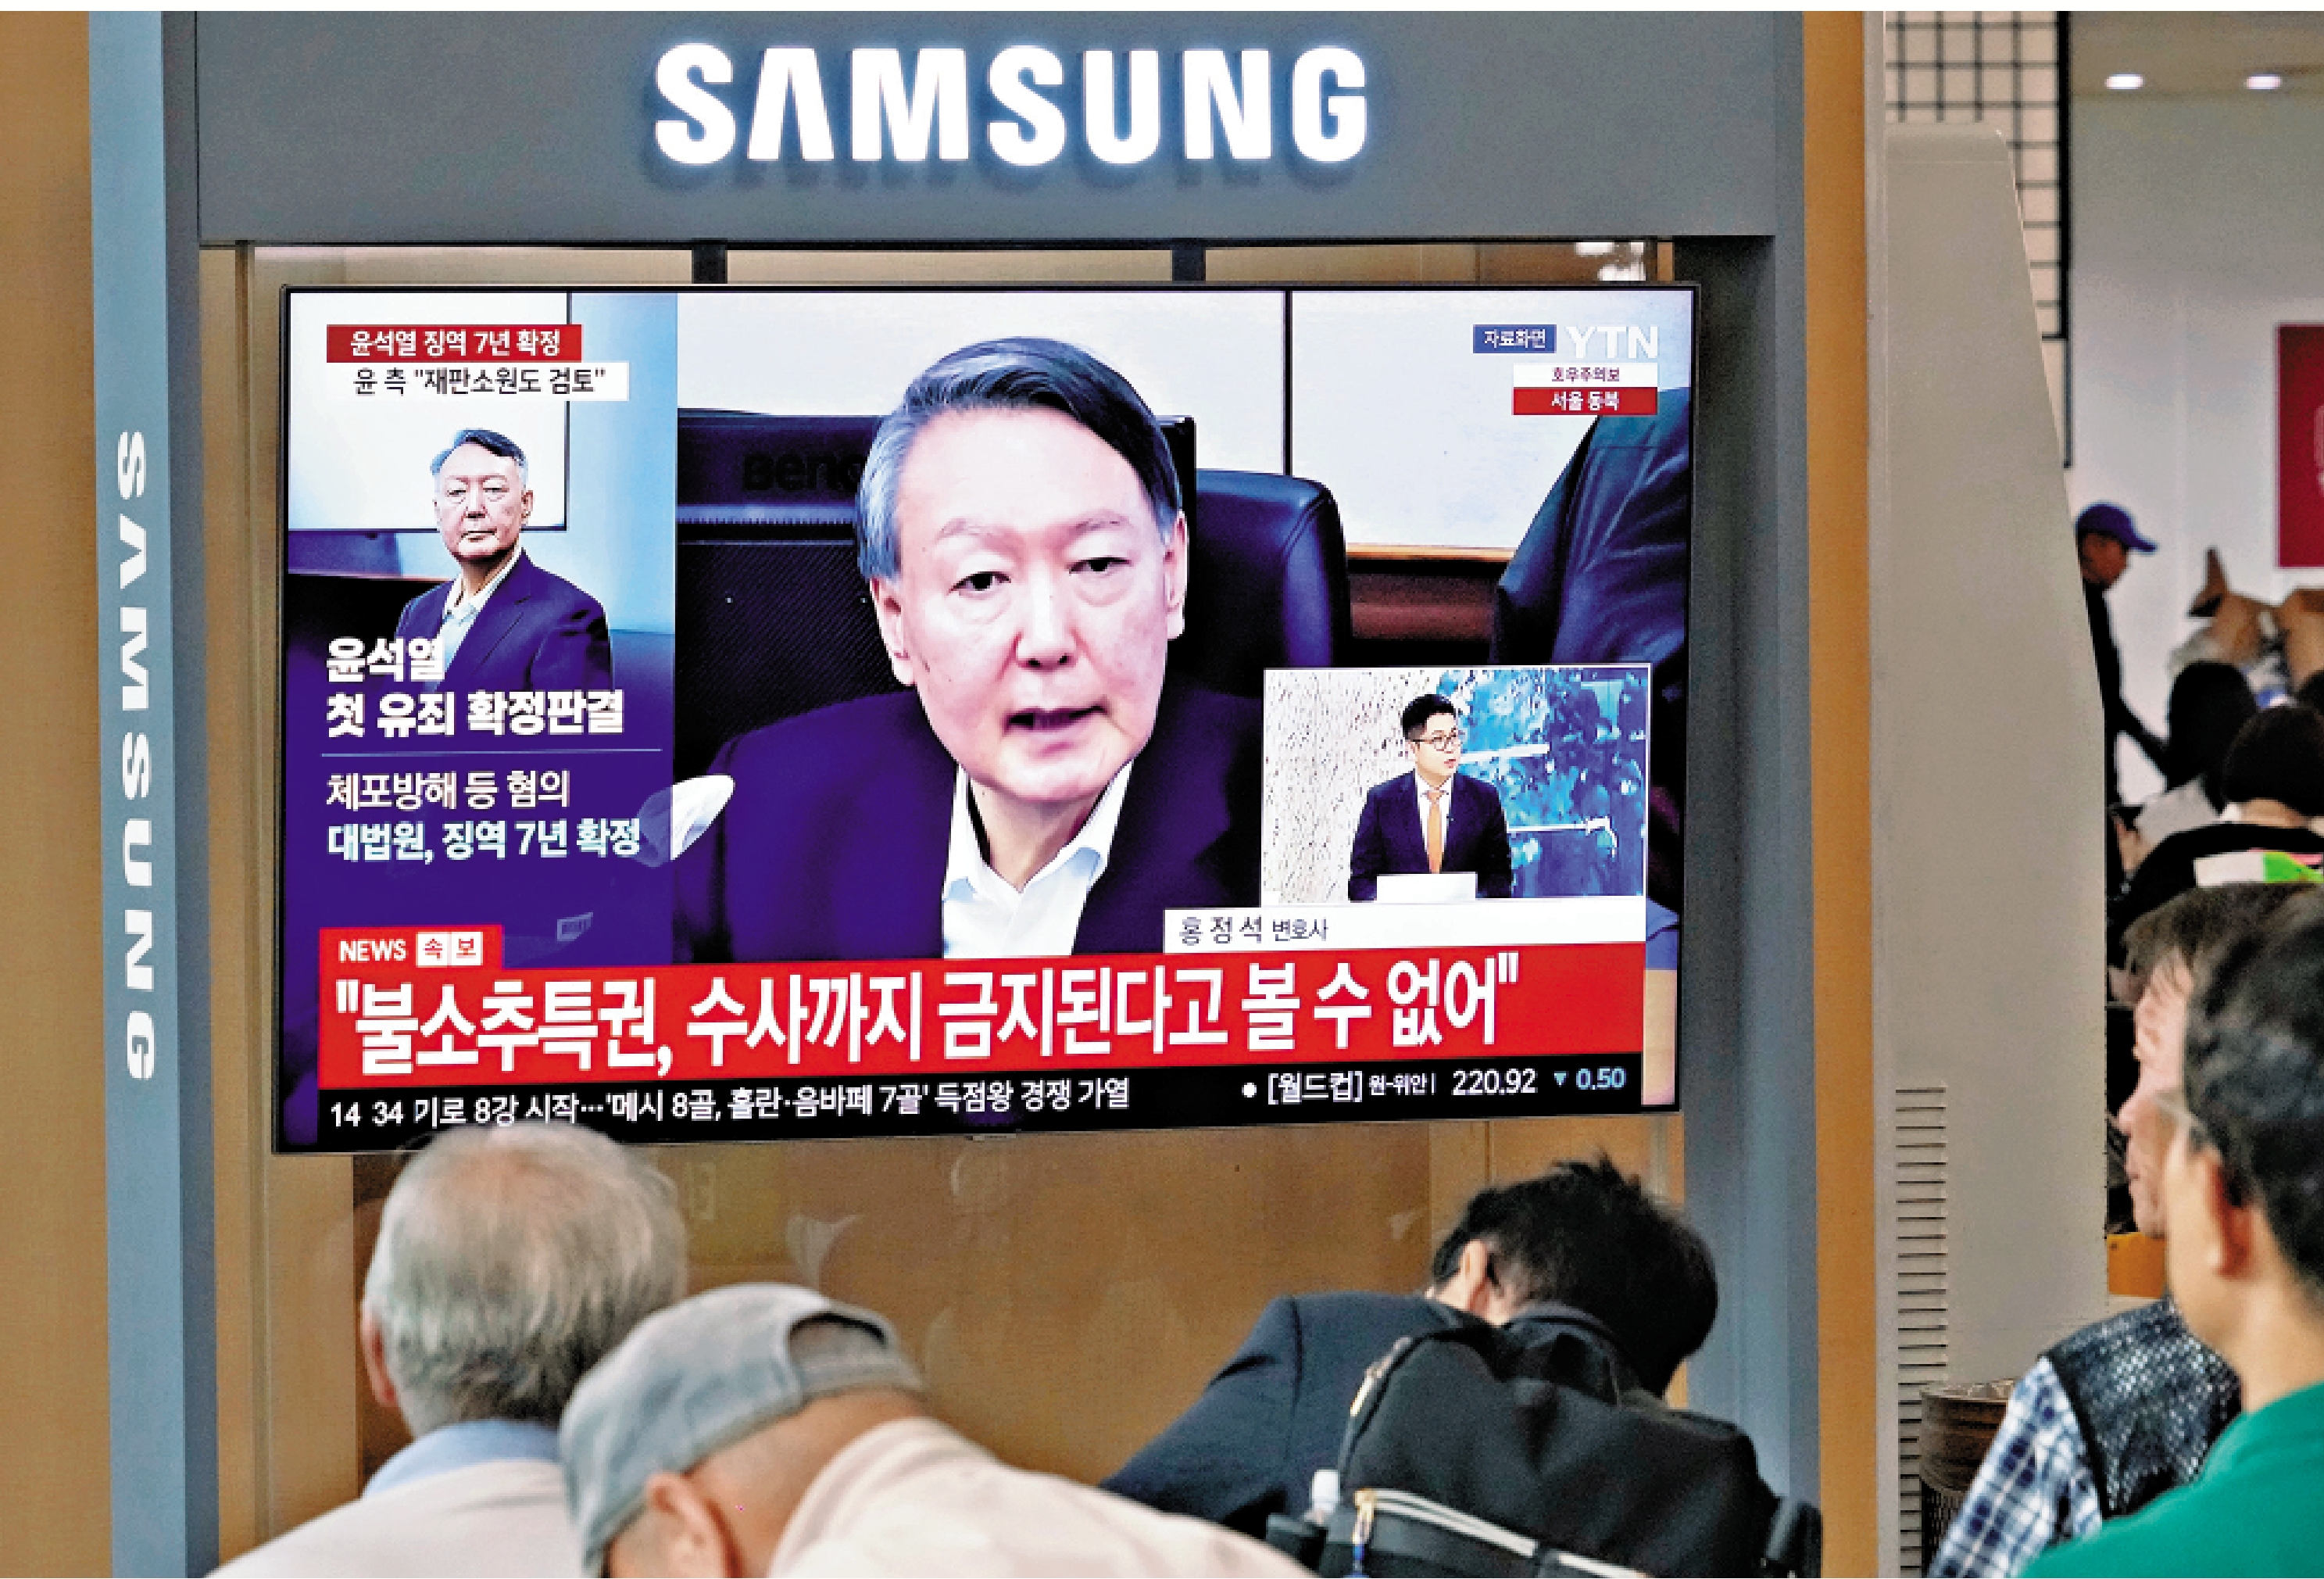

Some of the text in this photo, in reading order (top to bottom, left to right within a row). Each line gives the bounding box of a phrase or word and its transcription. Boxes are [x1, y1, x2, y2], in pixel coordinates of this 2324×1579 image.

[654, 41, 1368, 166] SAMSUNG
[350, 329, 561, 357] 윤석열 징역 7년 확정
[1483, 328, 1546, 349] 자료화면
[1565, 326, 1658, 359] YTN
[353, 367, 606, 396] 윤 측 "재판소원도 검토"
[1551, 367, 1620, 382] 호우주의보
[1550, 391, 1620, 411] 서울 동북
[326, 636, 445, 682] 윤석열
[327, 689, 625, 738] 첫 유죄 확정판결
[117, 430, 156, 1081] SAMSUNG
[326, 768, 570, 812] 체포방해 등 혐의
[327, 817, 642, 865] 대법원, 징역 7년 확정
[1272, 918, 1328, 942] 변호사
[338, 938, 409, 964] NEWS
[336, 951, 1518, 1076] "불소추특권, 수사까지 금지된다고 볼 수 없어"
[474, 1093, 520, 1127] 8강
[671, 1088, 721, 1122] 8골,
[935, 1080, 1014, 1115] 득점왕
[1021, 1078, 1071, 1112] 경쟁
[1078, 1076, 1129, 1111] 가열
[1268, 1071, 1363, 1105] [월드컵]
[1451, 1068, 1538, 1096] 220.92
[1576, 1066, 1627, 1090] 0.50
